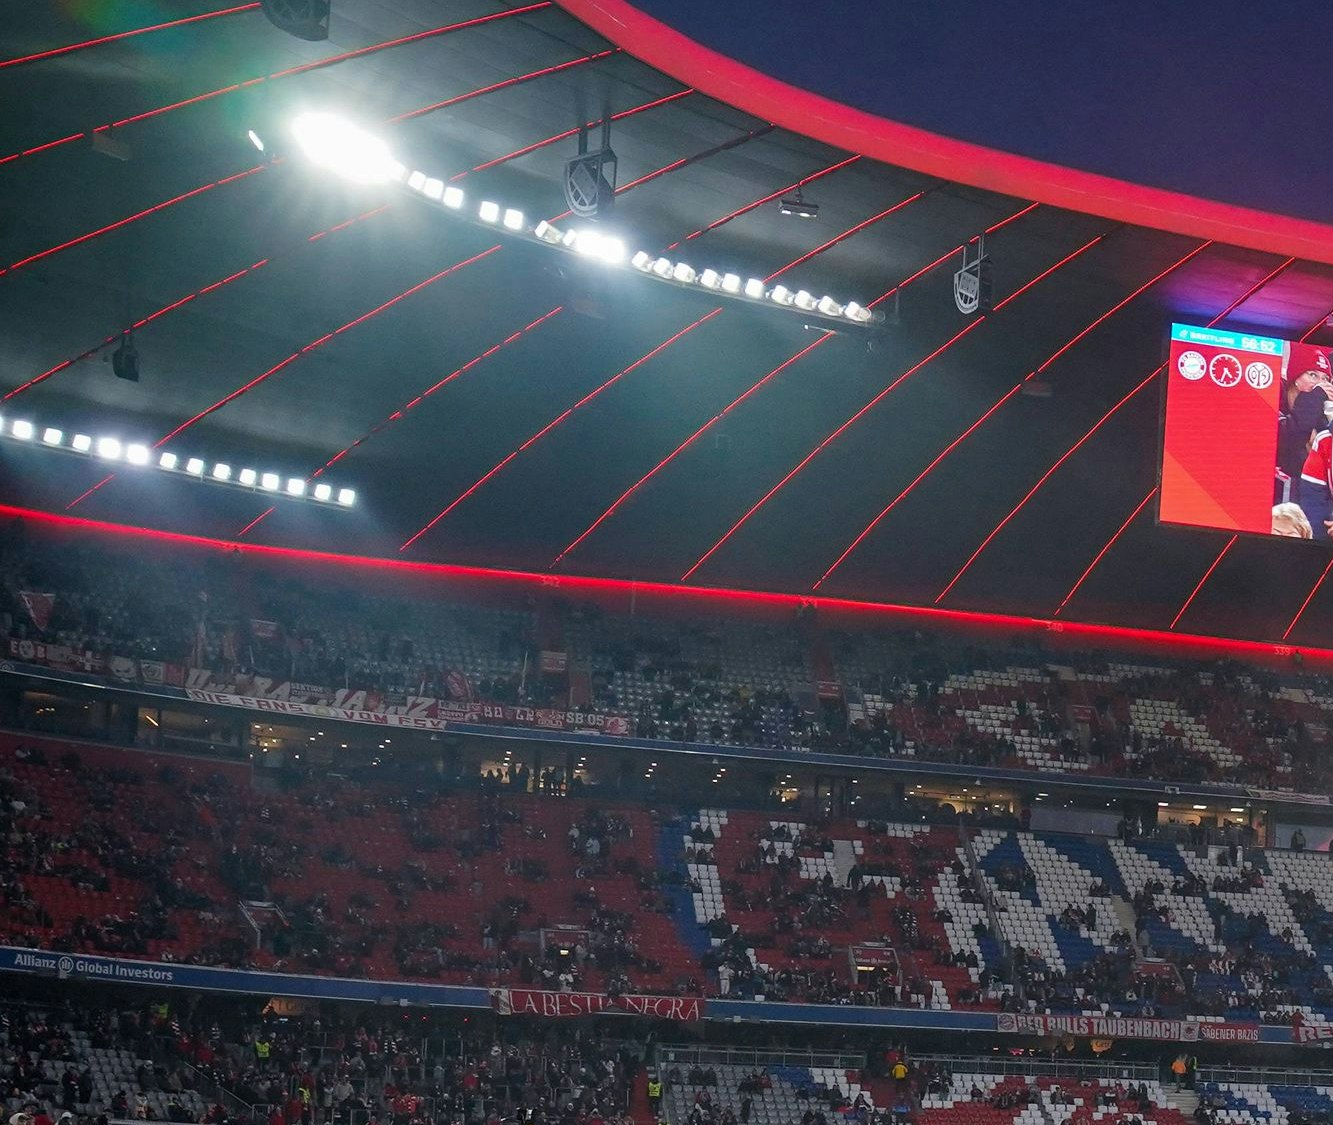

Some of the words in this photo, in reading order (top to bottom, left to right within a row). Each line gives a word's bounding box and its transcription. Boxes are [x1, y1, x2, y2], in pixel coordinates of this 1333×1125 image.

[14, 953, 57, 969] Allianz
[75, 960, 113, 976] Global
[115, 966, 174, 981] Investors
[509, 990, 539, 1014] LA
[625, 997, 701, 1021] NEGRA
[1091, 1017, 1181, 1040] TAUBENBACH
